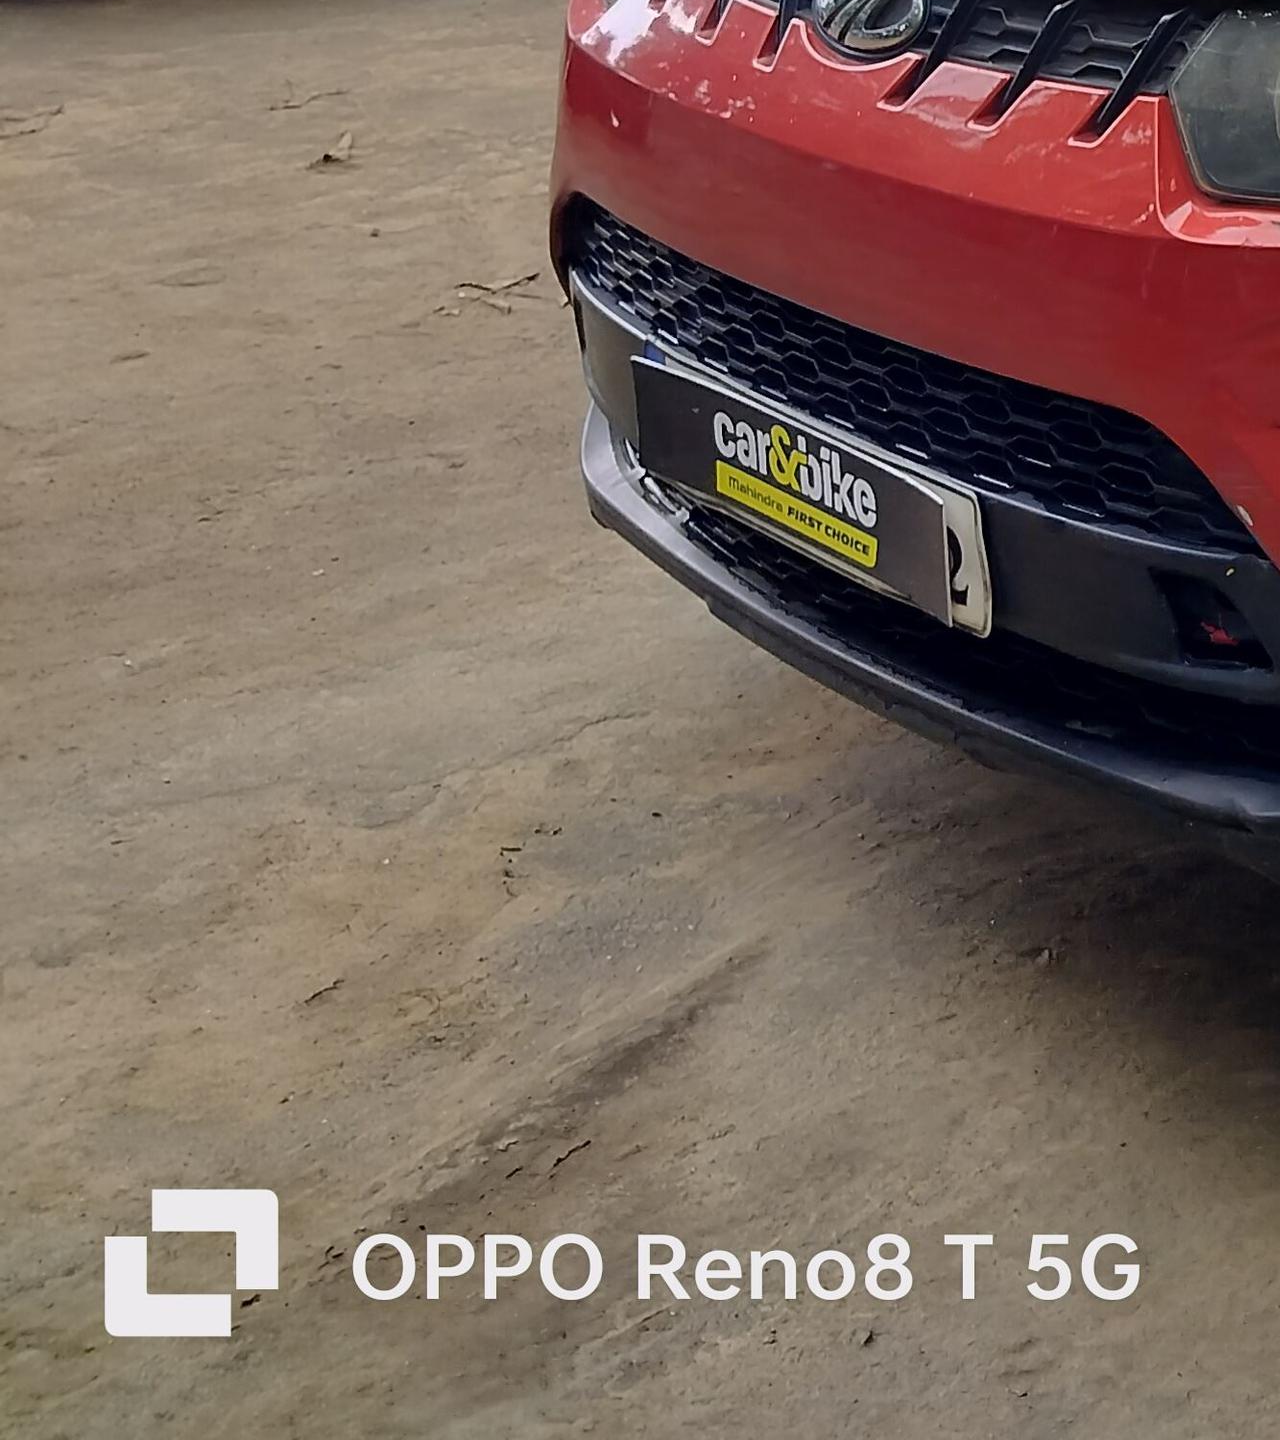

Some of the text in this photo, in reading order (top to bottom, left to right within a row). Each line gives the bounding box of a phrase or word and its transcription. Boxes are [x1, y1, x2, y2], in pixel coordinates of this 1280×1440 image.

[713, 411, 878, 528] car&bike
[728, 474, 871, 557] Mahindra FIRST CHOICE
